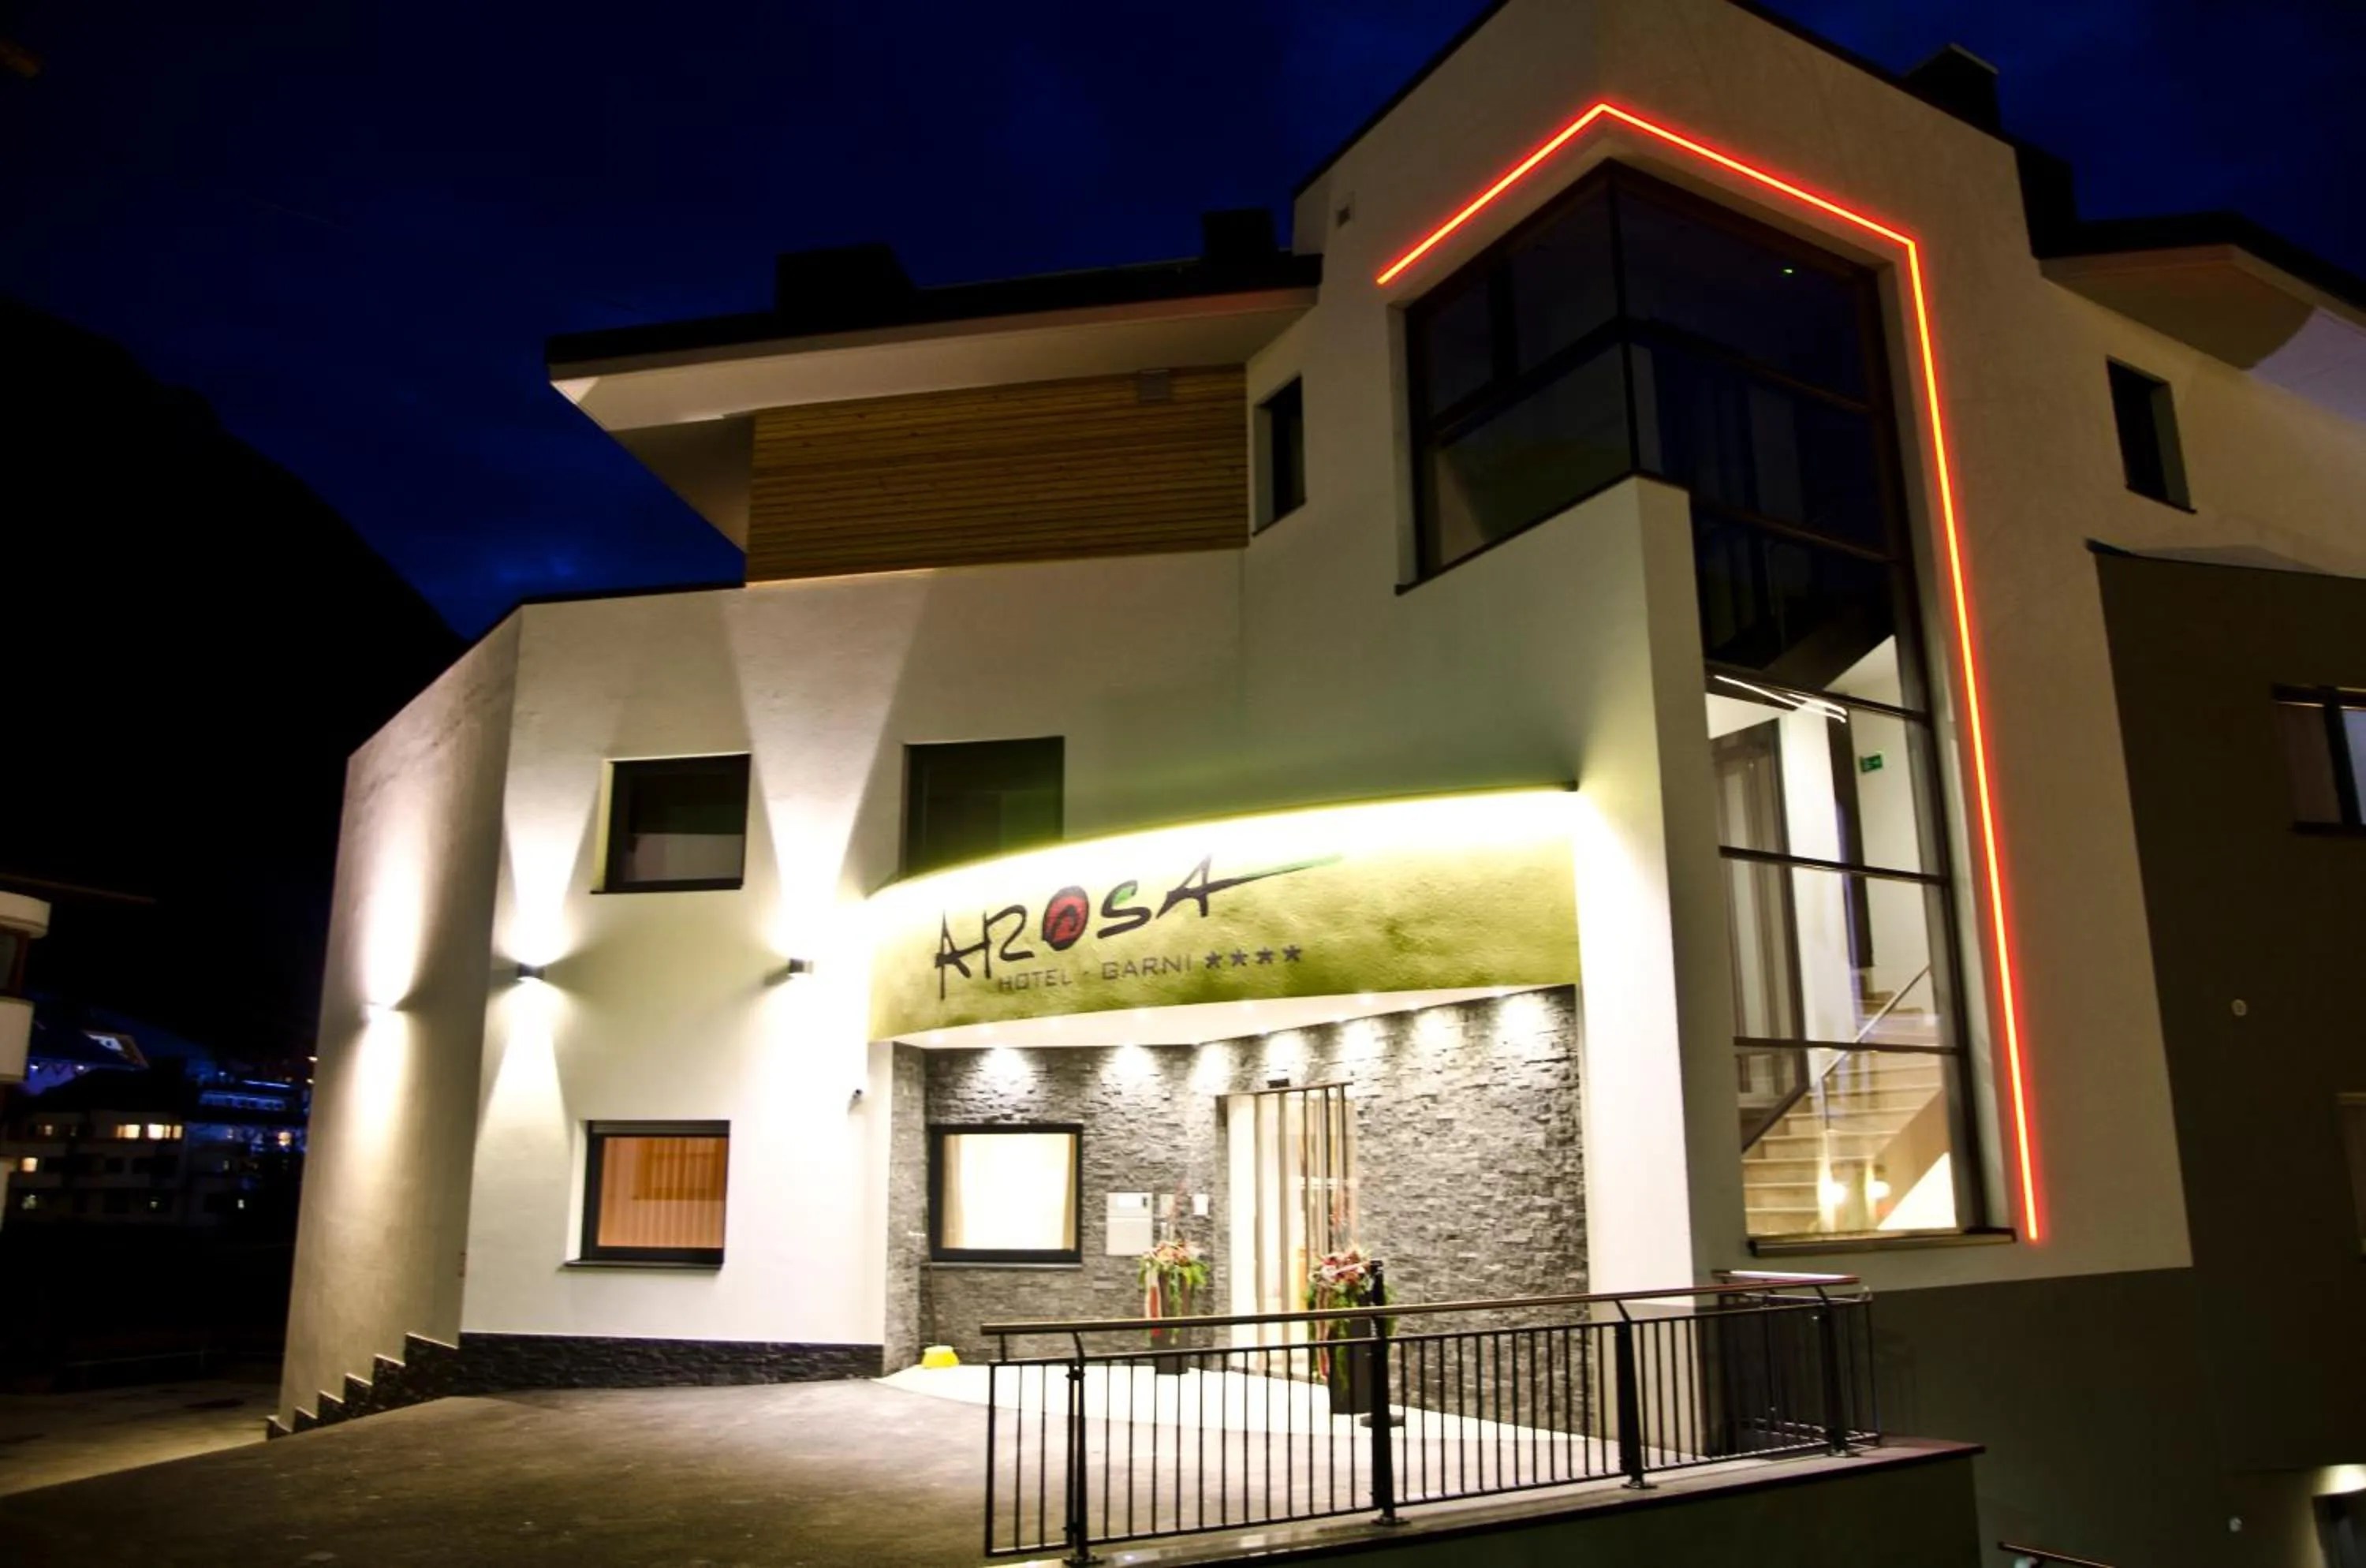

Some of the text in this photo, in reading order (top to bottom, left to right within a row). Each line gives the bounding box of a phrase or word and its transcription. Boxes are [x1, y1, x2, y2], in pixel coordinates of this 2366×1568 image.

[935, 854, 1315, 1000] AROSA
[998, 954, 1192, 992] HOTEL GARNI
